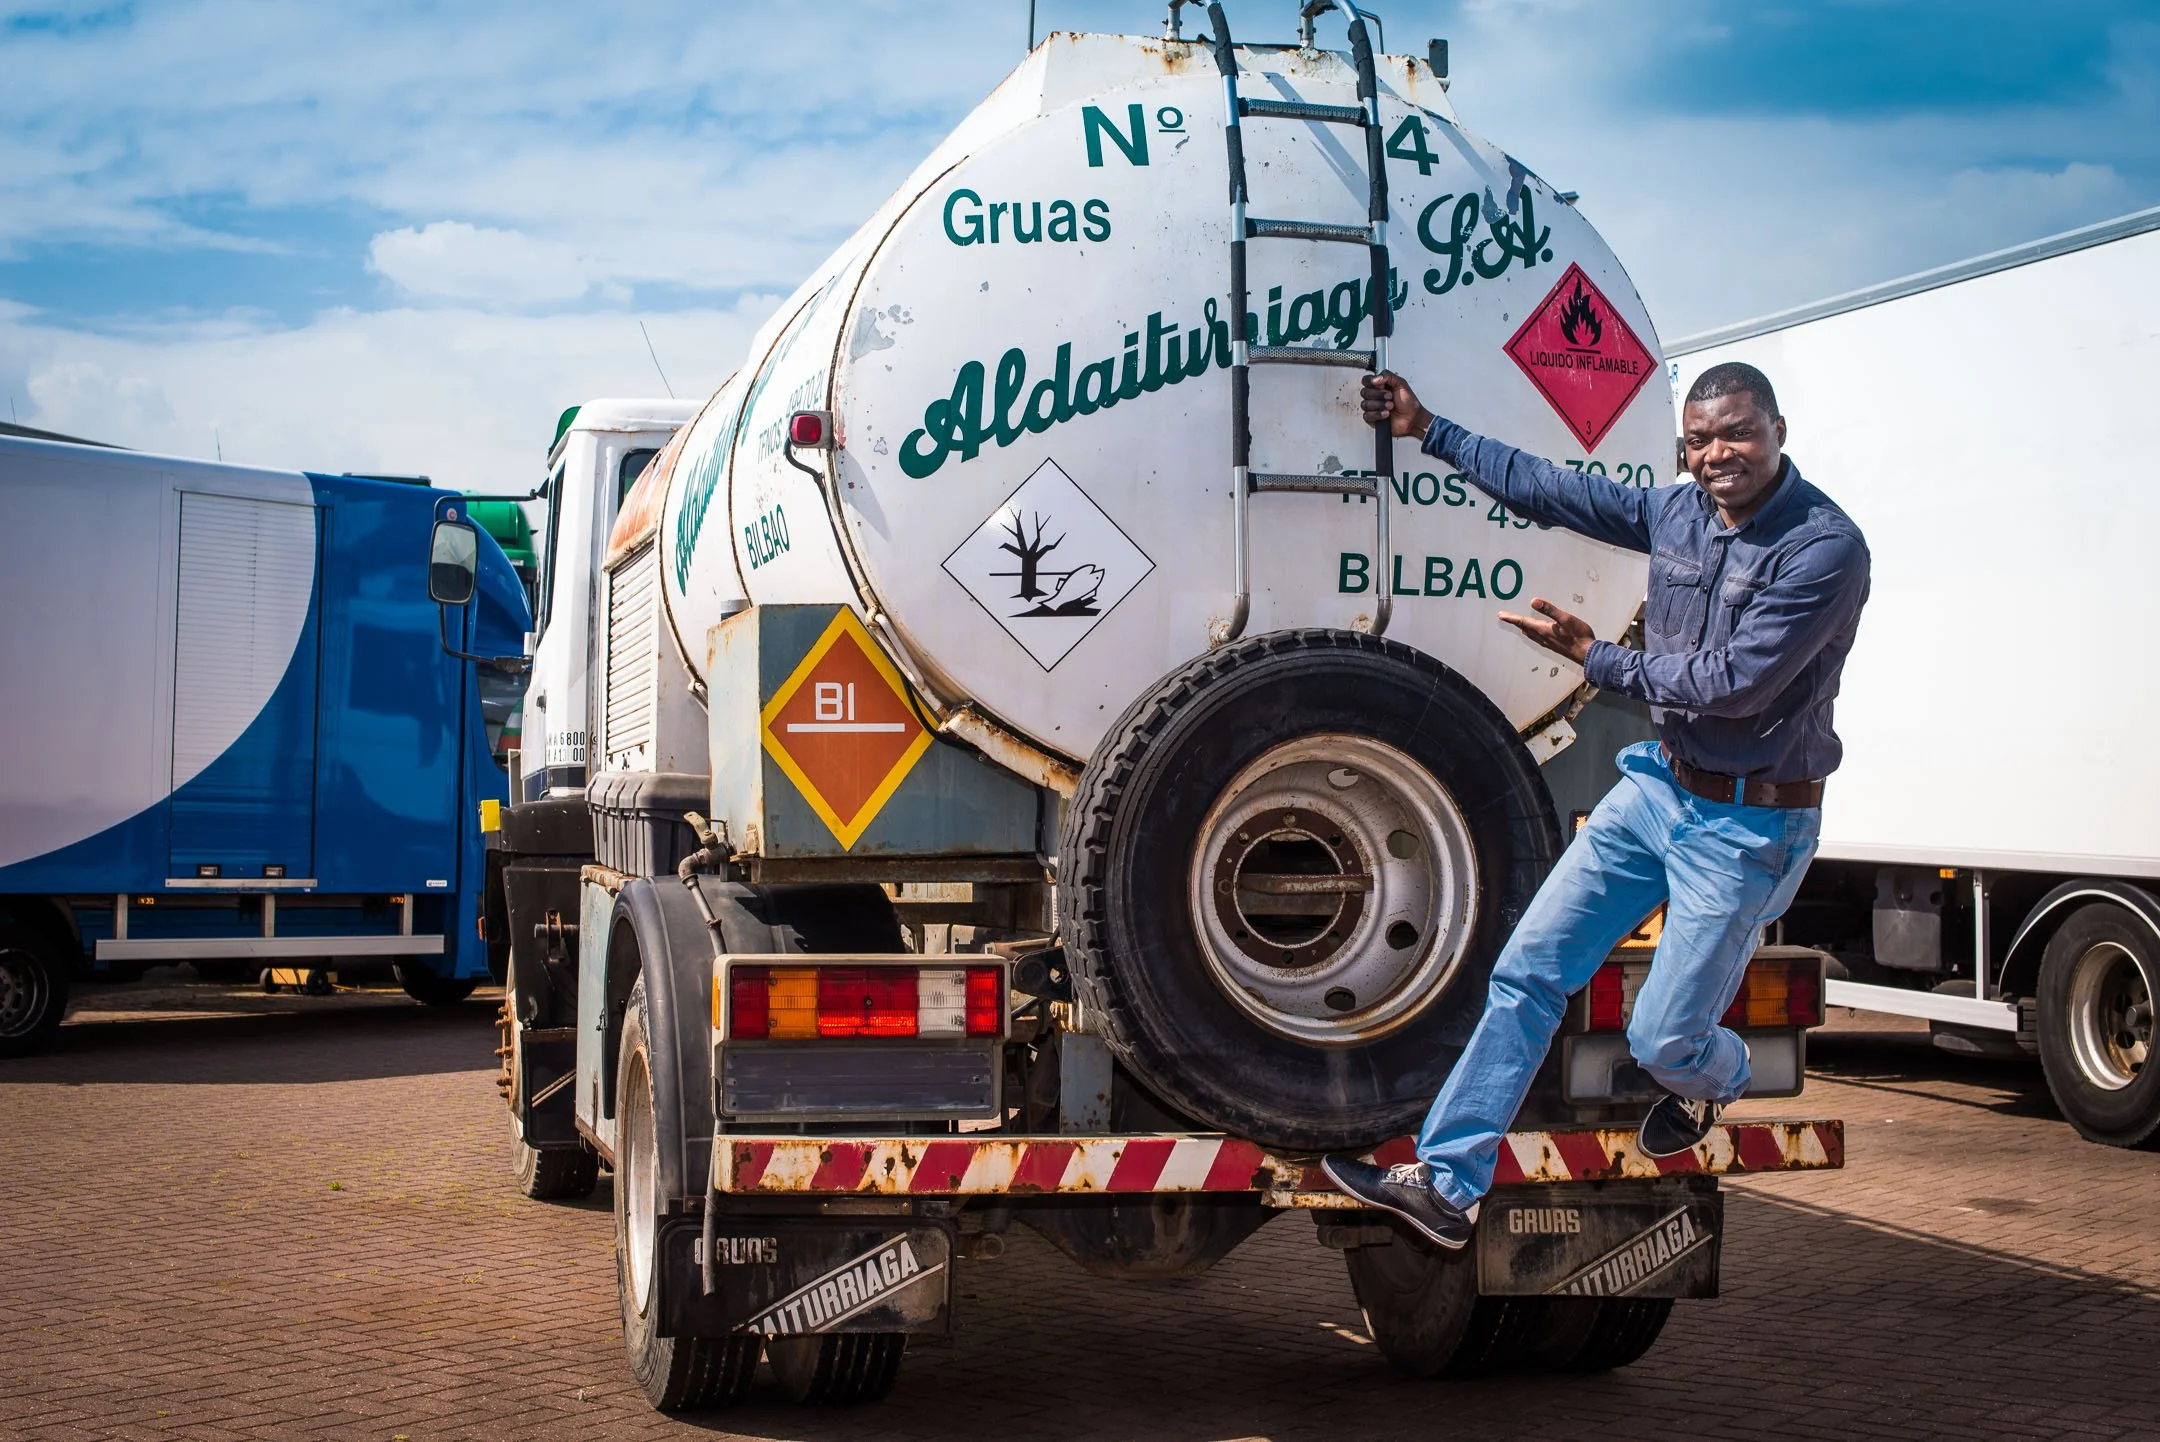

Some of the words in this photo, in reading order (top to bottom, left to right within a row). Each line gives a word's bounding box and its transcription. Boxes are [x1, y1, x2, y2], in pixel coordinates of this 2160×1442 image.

[1386, 115, 1440, 176] 4
[943, 188, 1111, 246] Gruas
[1530, 351, 1573, 369] LIQUIDO
[1576, 354, 1639, 375] INFLAMABLE
[1585, 420, 1592, 435] 3
[745, 504, 790, 570] BILBAO
[1338, 552, 1523, 600] BLBAO
[1508, 1208, 1581, 1234] GRUAS
[1557, 1212, 1697, 1296] ITURRIAGA
